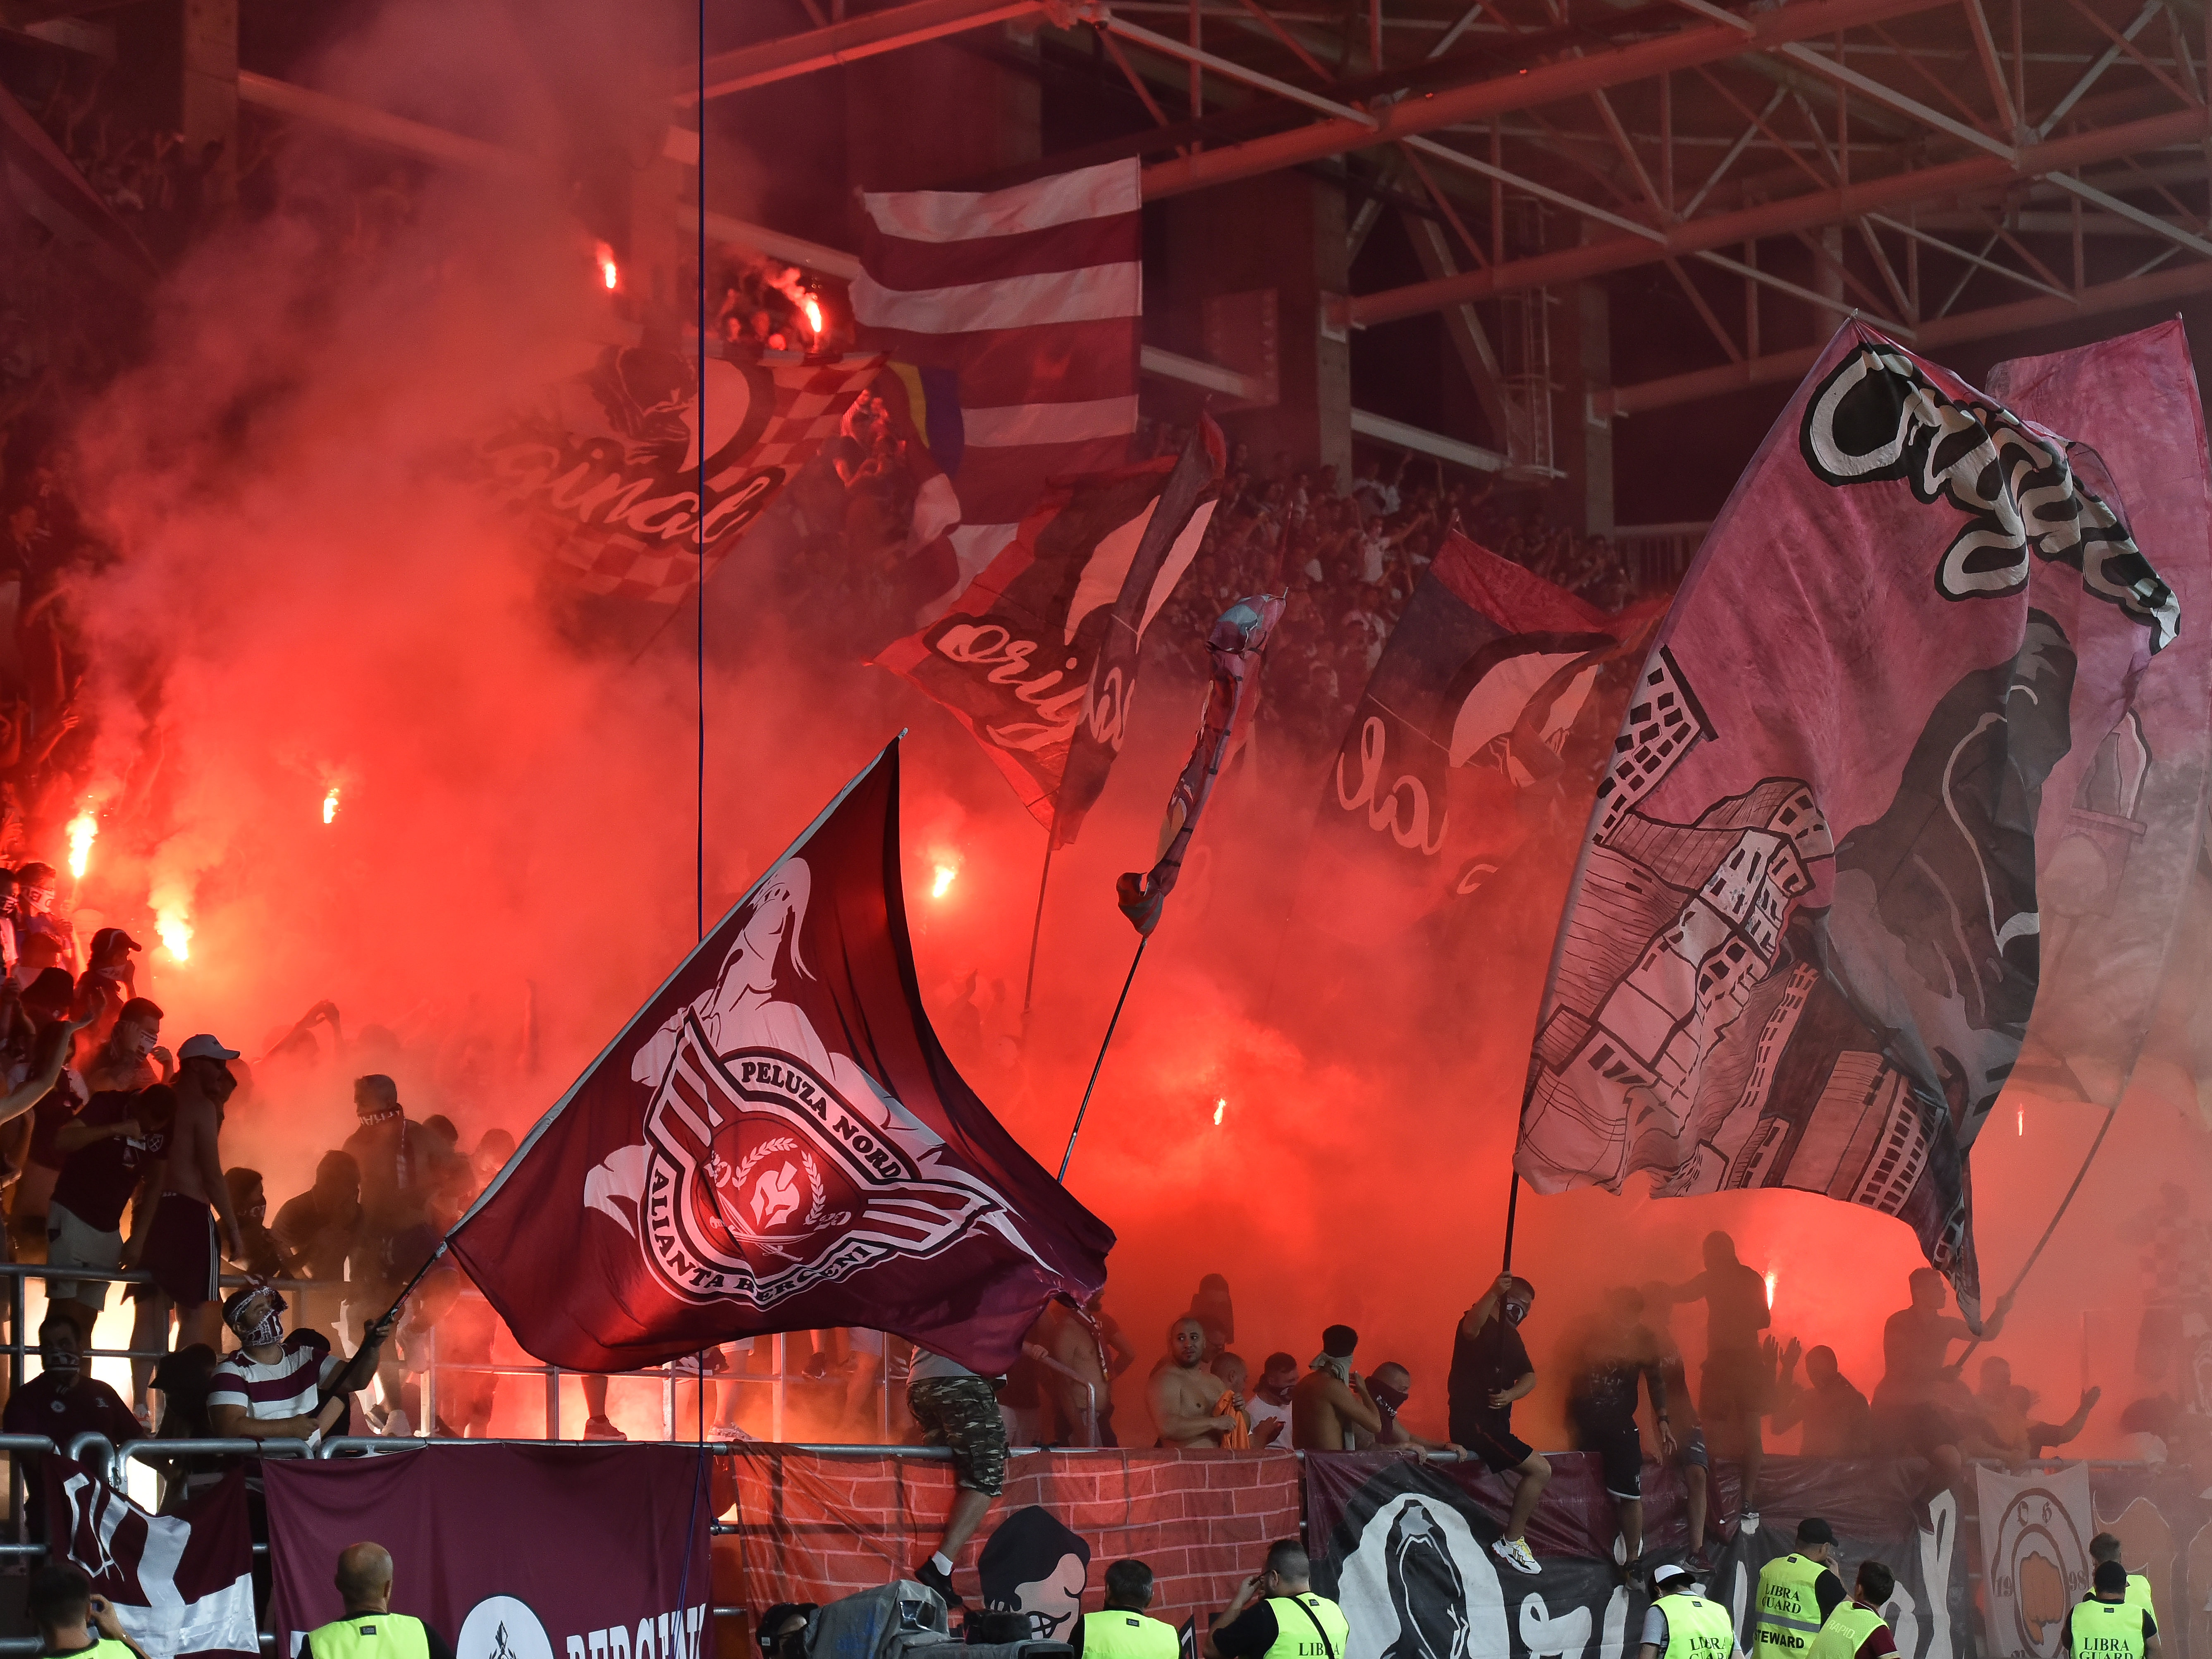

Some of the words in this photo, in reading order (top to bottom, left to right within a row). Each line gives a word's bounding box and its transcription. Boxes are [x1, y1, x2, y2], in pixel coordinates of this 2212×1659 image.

[741, 1061, 827, 1121] PELUZA
[832, 1115, 902, 1178] NORD
[651, 1168, 725, 1288] ALIANTA
[1765, 1583, 1801, 1602] LIBRA
[1761, 1596, 1801, 1614] GUARD
[1754, 1628, 1805, 1649] STEWARD
[1827, 1619, 1856, 1639] RAPID
[1298, 1641, 1340, 1656] LIBA
[2084, 1637, 2130, 1651] LIBRA
